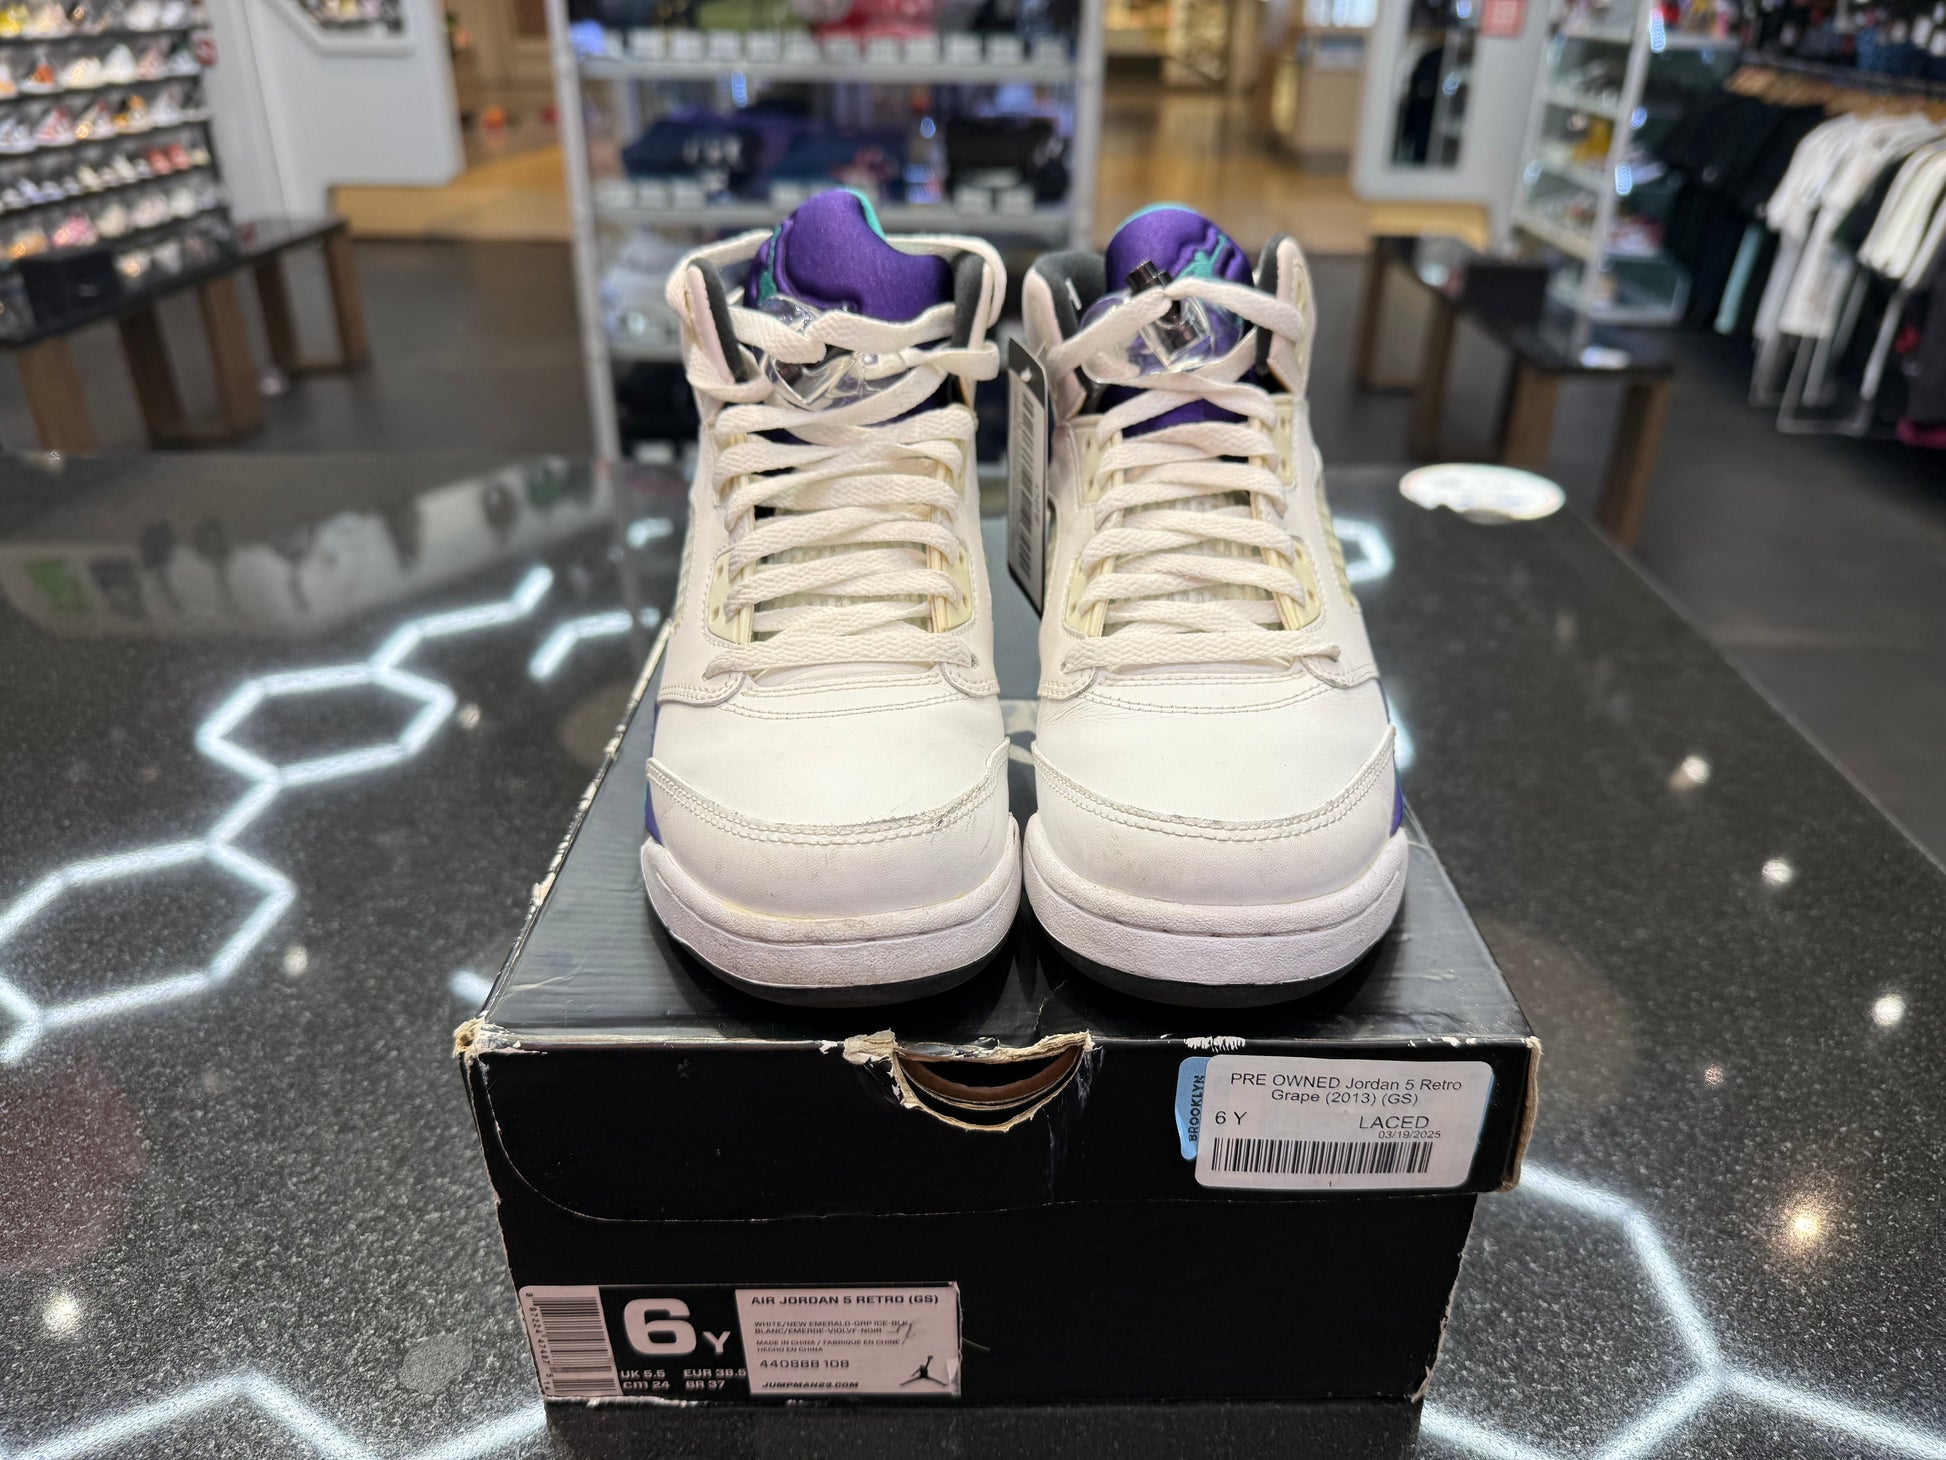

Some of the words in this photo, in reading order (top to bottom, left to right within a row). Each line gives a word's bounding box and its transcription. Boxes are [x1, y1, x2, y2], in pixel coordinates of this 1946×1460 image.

[1230, 1072, 1267, 1086] PRE
[1272, 1074, 1341, 1089] OWNED
[1345, 1077, 1400, 1090] Jordan
[1404, 1079, 1415, 1091] 5
[1419, 1078, 1462, 1091] Retro
[1271, 1089, 1320, 1104] Grape
[1325, 1091, 1377, 1107] (2013)
[1381, 1092, 1418, 1107] (GS)
[1187, 1075, 1205, 1143] BROOKLYN
[1215, 1110, 1227, 1125] 6
[1233, 1111, 1248, 1126] Y
[1359, 1115, 1430, 1130] LACED
[1378, 1130, 1442, 1139] 03/19/2025
[751, 1296, 776, 1305] AIR
[779, 1296, 839, 1305] JORDAN
[843, 1296, 852, 1304] 5
[856, 1295, 906, 1304] RETRO
[909, 1294, 939, 1305] (GS)
[623, 1298, 697, 1355] 6
[702, 1330, 731, 1354] Y
[754, 1320, 807, 1328] WHITE/NEW
[760, 1359, 820, 1369] 440888
[620, 1369, 641, 1379] UK
[643, 1369, 666, 1379] 5.5
[683, 1368, 712, 1378] EUR
[715, 1368, 747, 1378] 38.5
[623, 1381, 649, 1390] cm
[652, 1380, 671, 1389] 24
[685, 1380, 705, 1390] BR
[708, 1380, 726, 1390] 37
[762, 1381, 860, 1389] JUMPMAN23.COM
